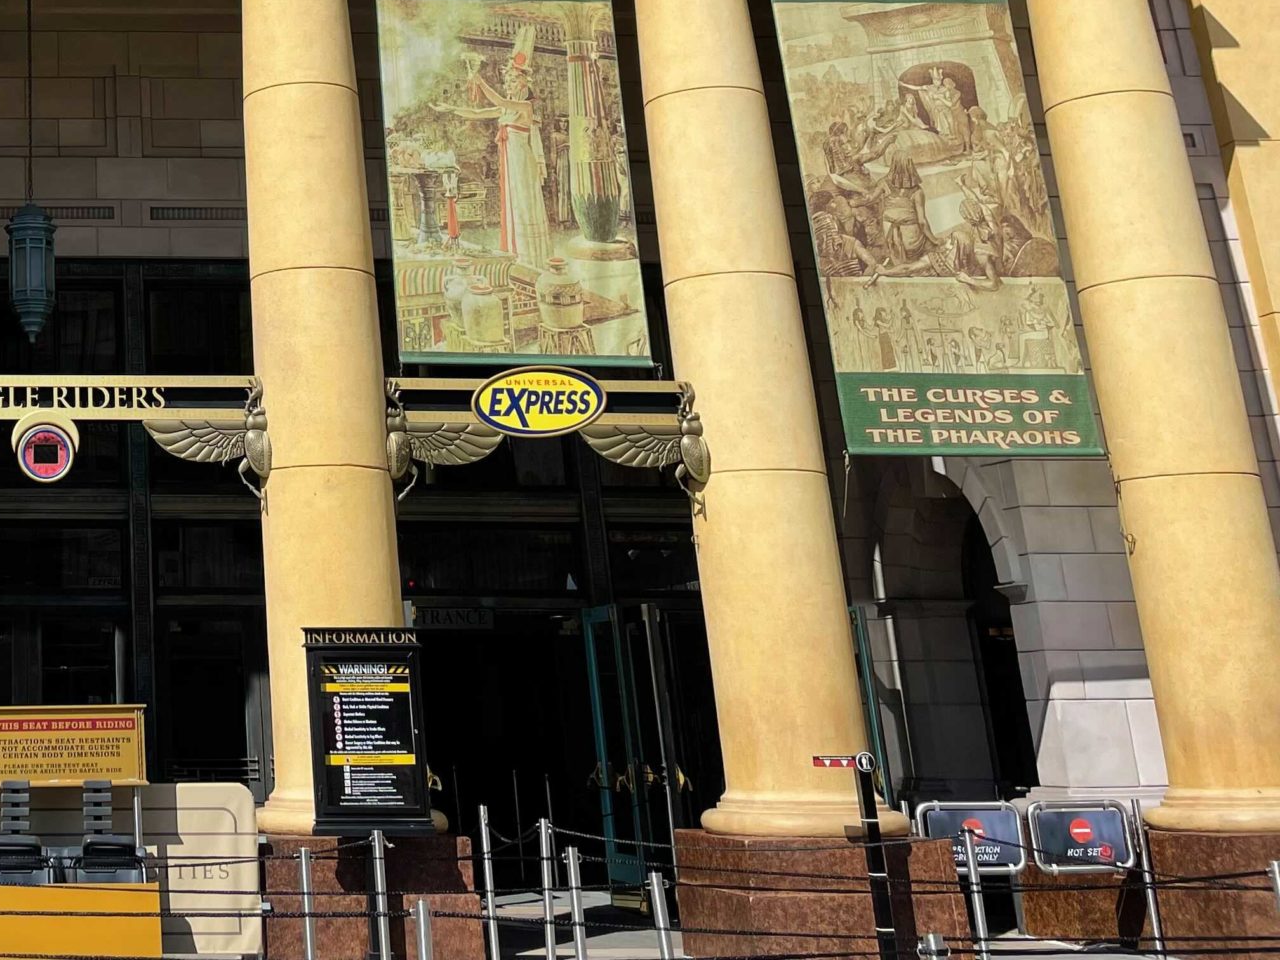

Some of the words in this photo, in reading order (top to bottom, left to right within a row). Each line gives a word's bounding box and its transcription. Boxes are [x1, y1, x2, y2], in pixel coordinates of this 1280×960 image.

[53, 386, 166, 409] RIDERS
[860, 388, 918, 402] THE
[926, 389, 1040, 408] CURSES
[1048, 389, 1073, 404] &
[488, 388, 591, 428] EXPRESS
[880, 408, 1014, 424] LEGENDS
[1022, 410, 1060, 424] OF
[866, 428, 924, 444] THE
[932, 429, 1081, 450] PHARAOHS
[307, 631, 417, 644] INFORMATION
[338, 664, 388, 674] WARNING!
[22, 722, 48, 730] SEAT
[51, 721, 92, 730] BEFORE
[96, 720, 133, 729] RIDING
[977, 853, 999, 861] ONLY
[1067, 848, 1084, 857] HOT
